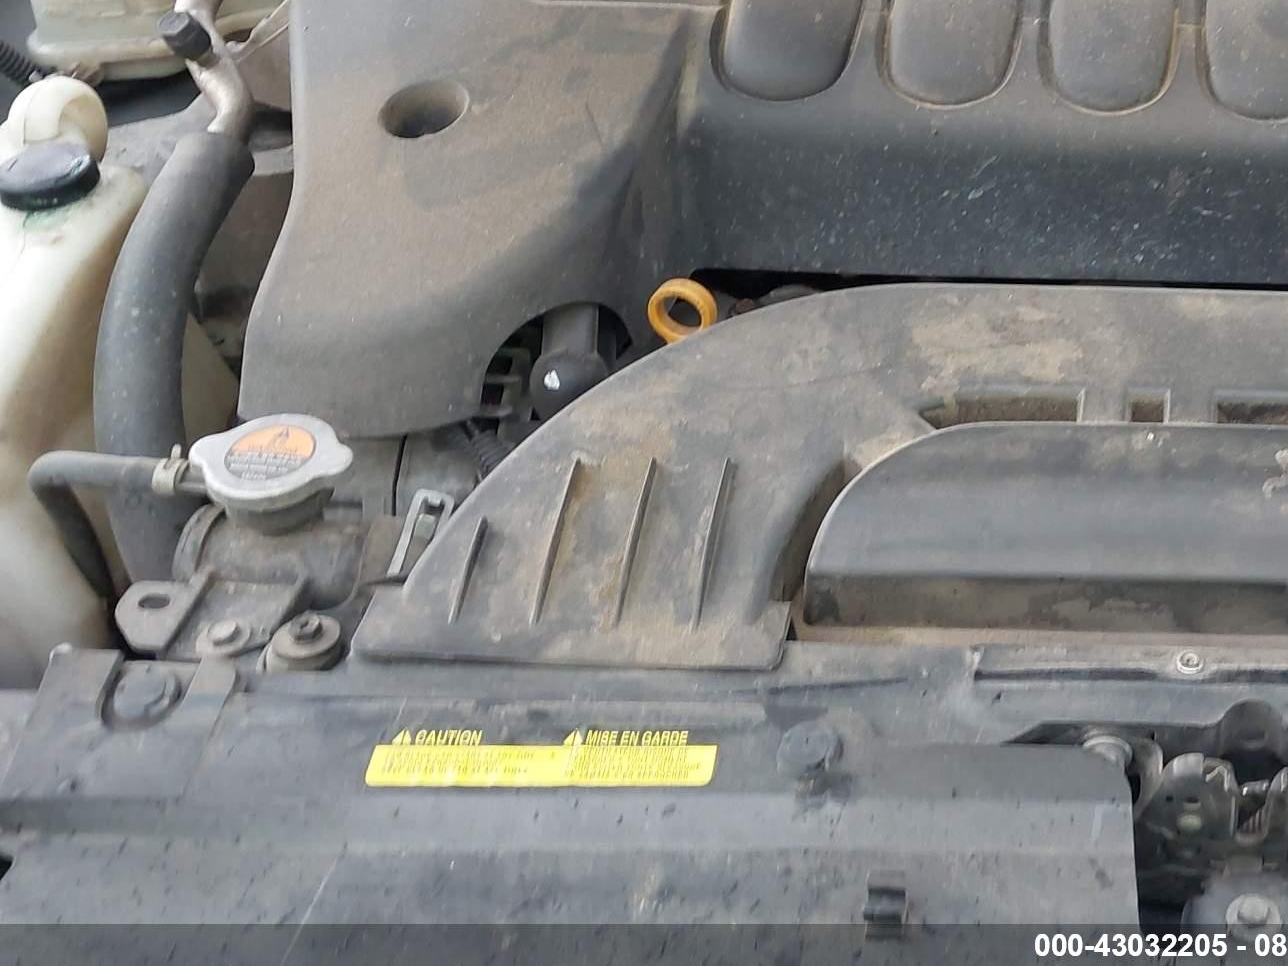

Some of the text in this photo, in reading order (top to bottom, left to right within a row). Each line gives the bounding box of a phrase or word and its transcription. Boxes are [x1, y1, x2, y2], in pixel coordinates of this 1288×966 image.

[414, 729, 483, 746] CAUTION
[585, 729, 689, 746] MISE EN GARDE
